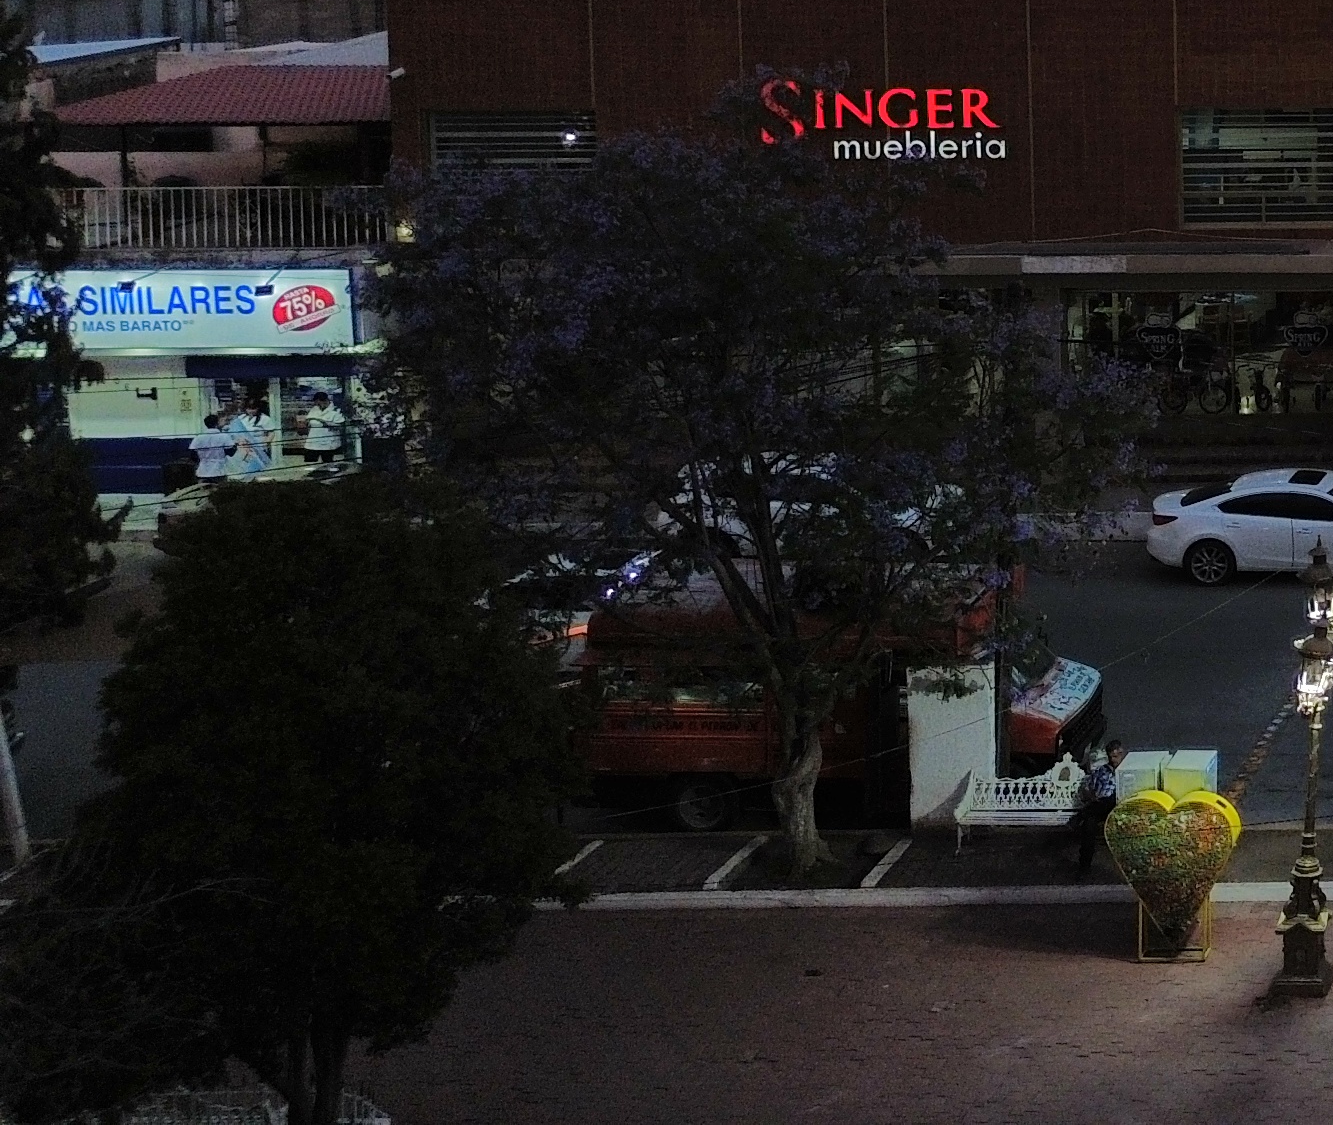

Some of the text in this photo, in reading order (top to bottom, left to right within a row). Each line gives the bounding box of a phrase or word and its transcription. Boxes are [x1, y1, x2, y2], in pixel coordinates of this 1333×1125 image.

[758, 77, 1004, 145] SINGER
[832, 131, 1007, 161] muebleria
[78, 284, 257, 317] SIMILARES
[279, 290, 326, 320] 75%
[82, 320, 116, 332] MAS
[119, 320, 182, 332] BARATO
